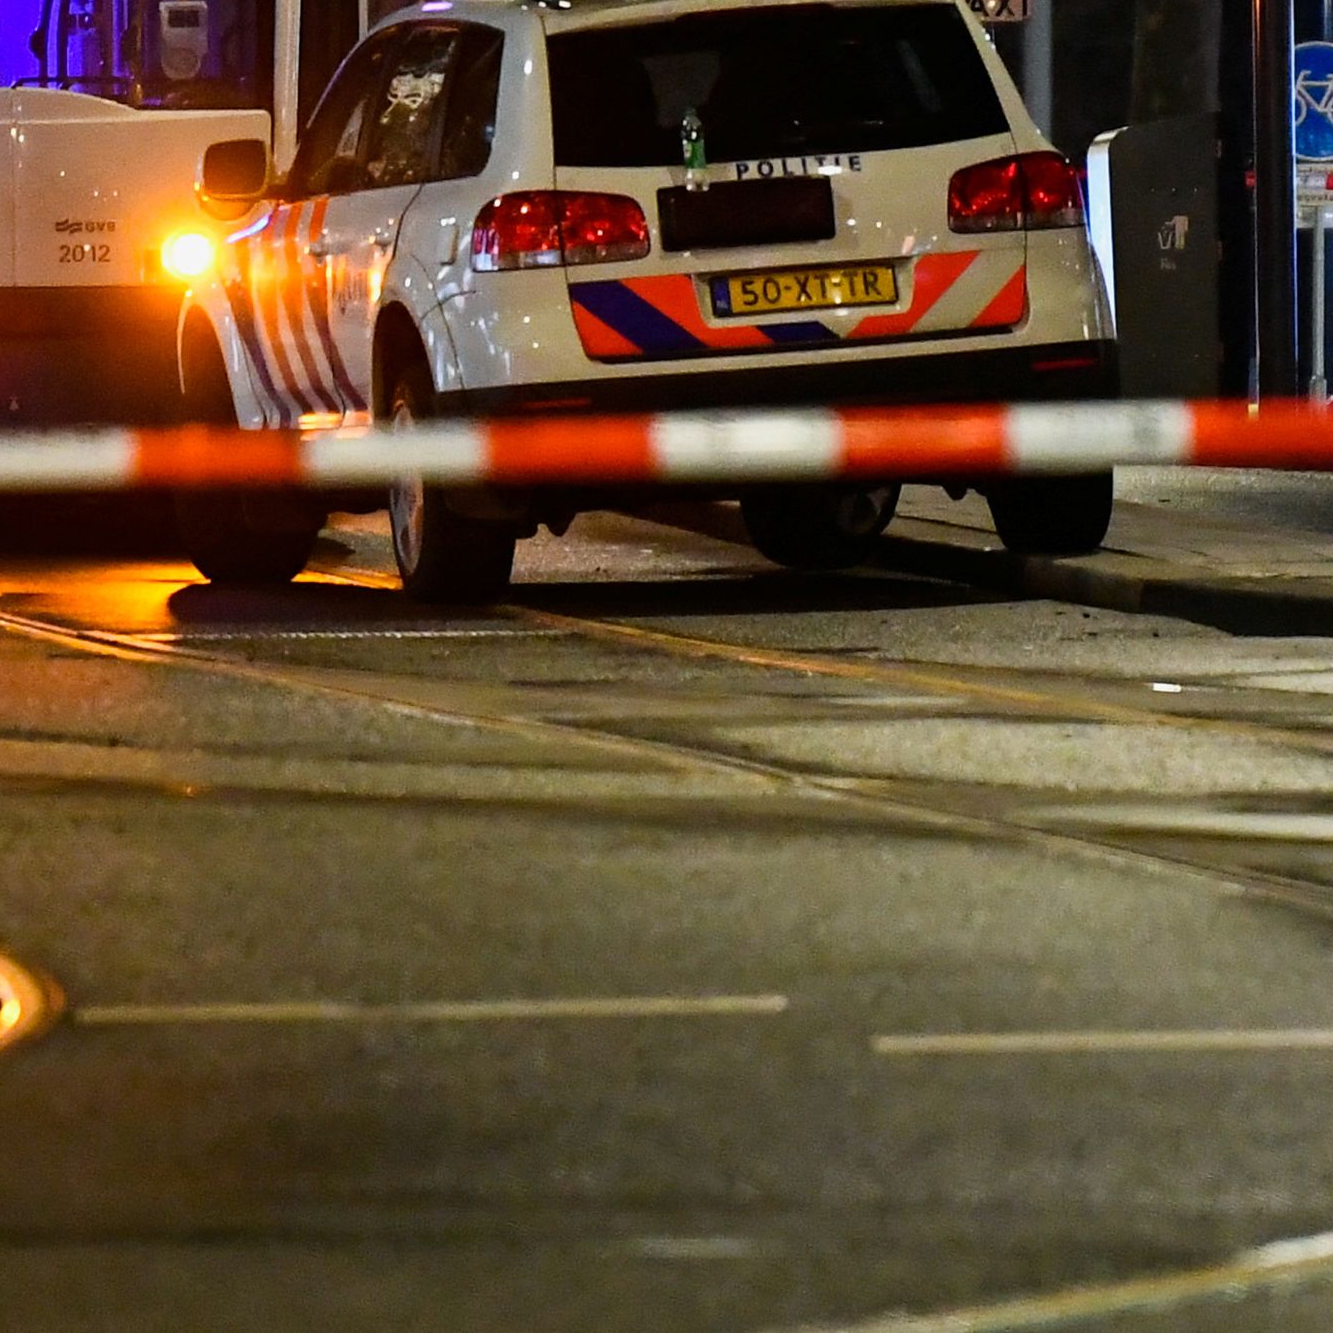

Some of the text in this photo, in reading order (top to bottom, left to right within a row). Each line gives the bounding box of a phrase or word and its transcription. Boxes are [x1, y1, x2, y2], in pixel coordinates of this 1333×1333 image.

[736, 155, 862, 180] POLITIE
[59, 244, 111, 264] 2012
[741, 270, 882, 307] 50-XT-TR
